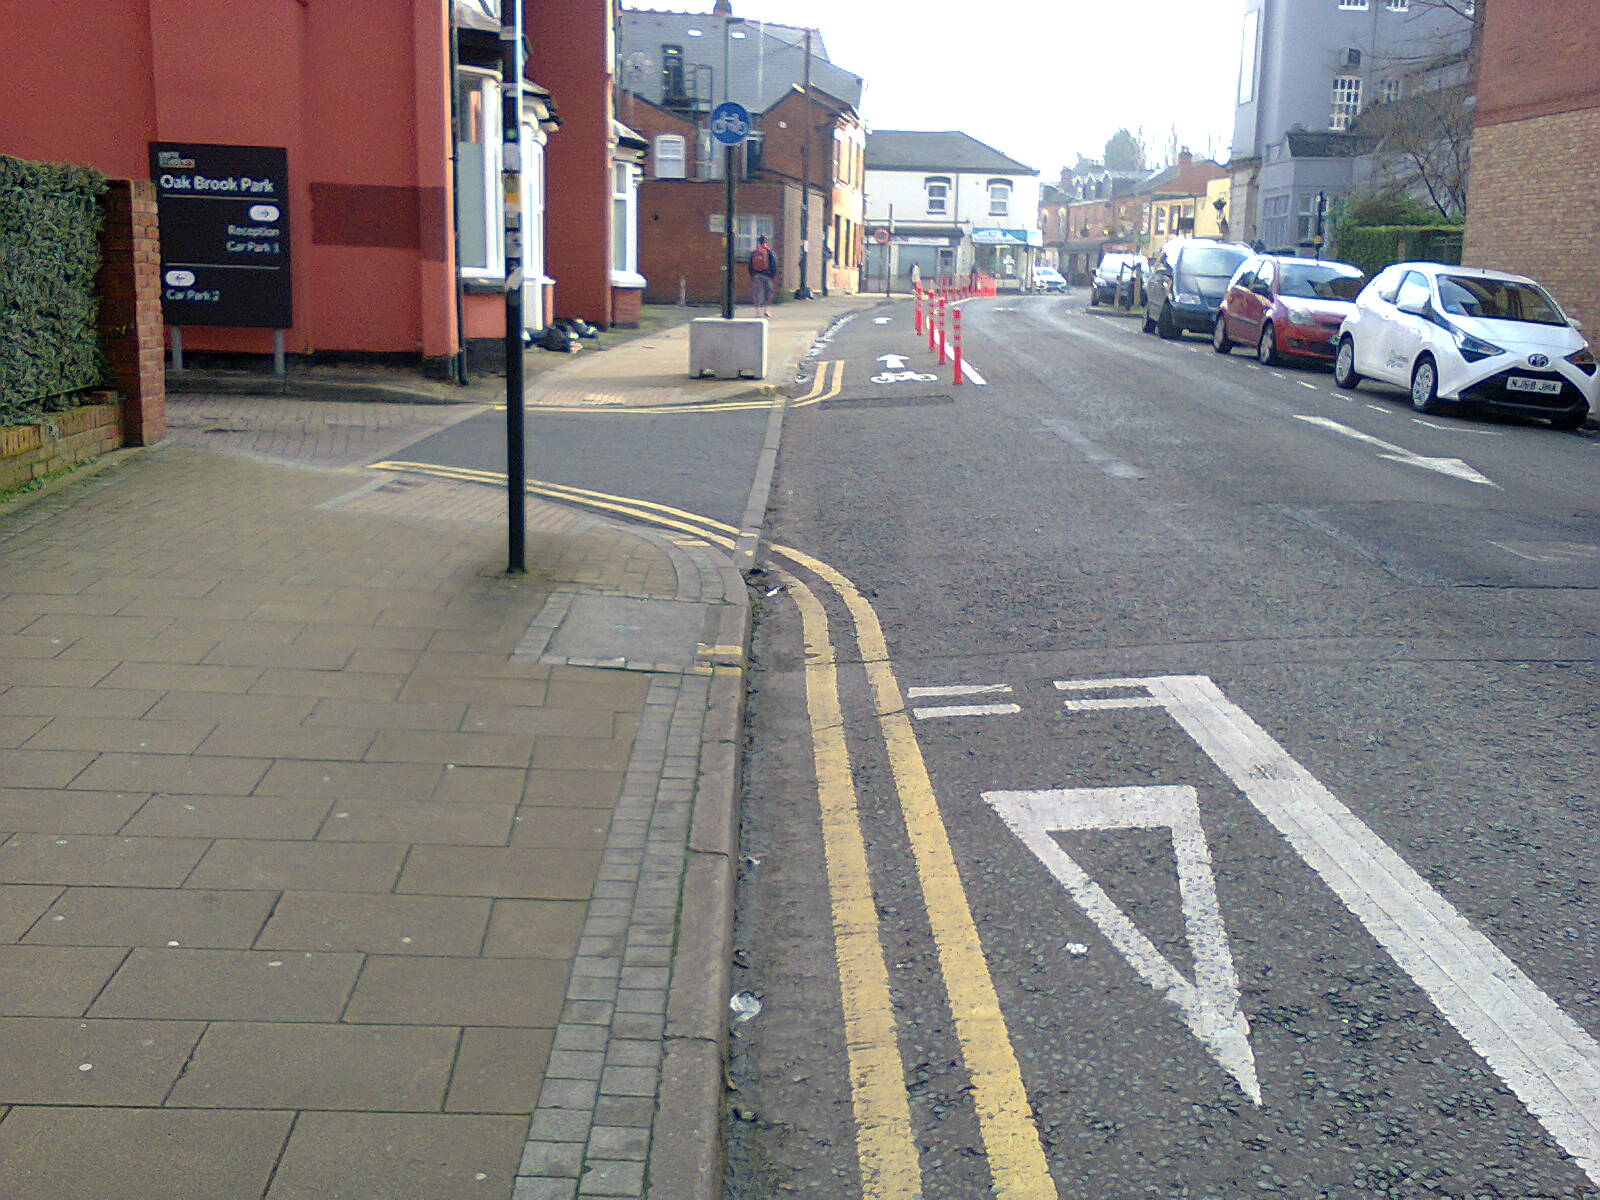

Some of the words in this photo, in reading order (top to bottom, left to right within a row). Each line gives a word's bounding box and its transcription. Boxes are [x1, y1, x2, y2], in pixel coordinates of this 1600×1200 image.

[160, 174, 192, 189] Oak
[193, 175, 239, 191] Brook
[240, 177, 274, 193] Park
[228, 225, 280, 237] Reception
[226, 240, 246, 252] Car
[247, 241, 271, 253] Park
[165, 289, 185, 300] Car
[186, 290, 211, 301] Park
